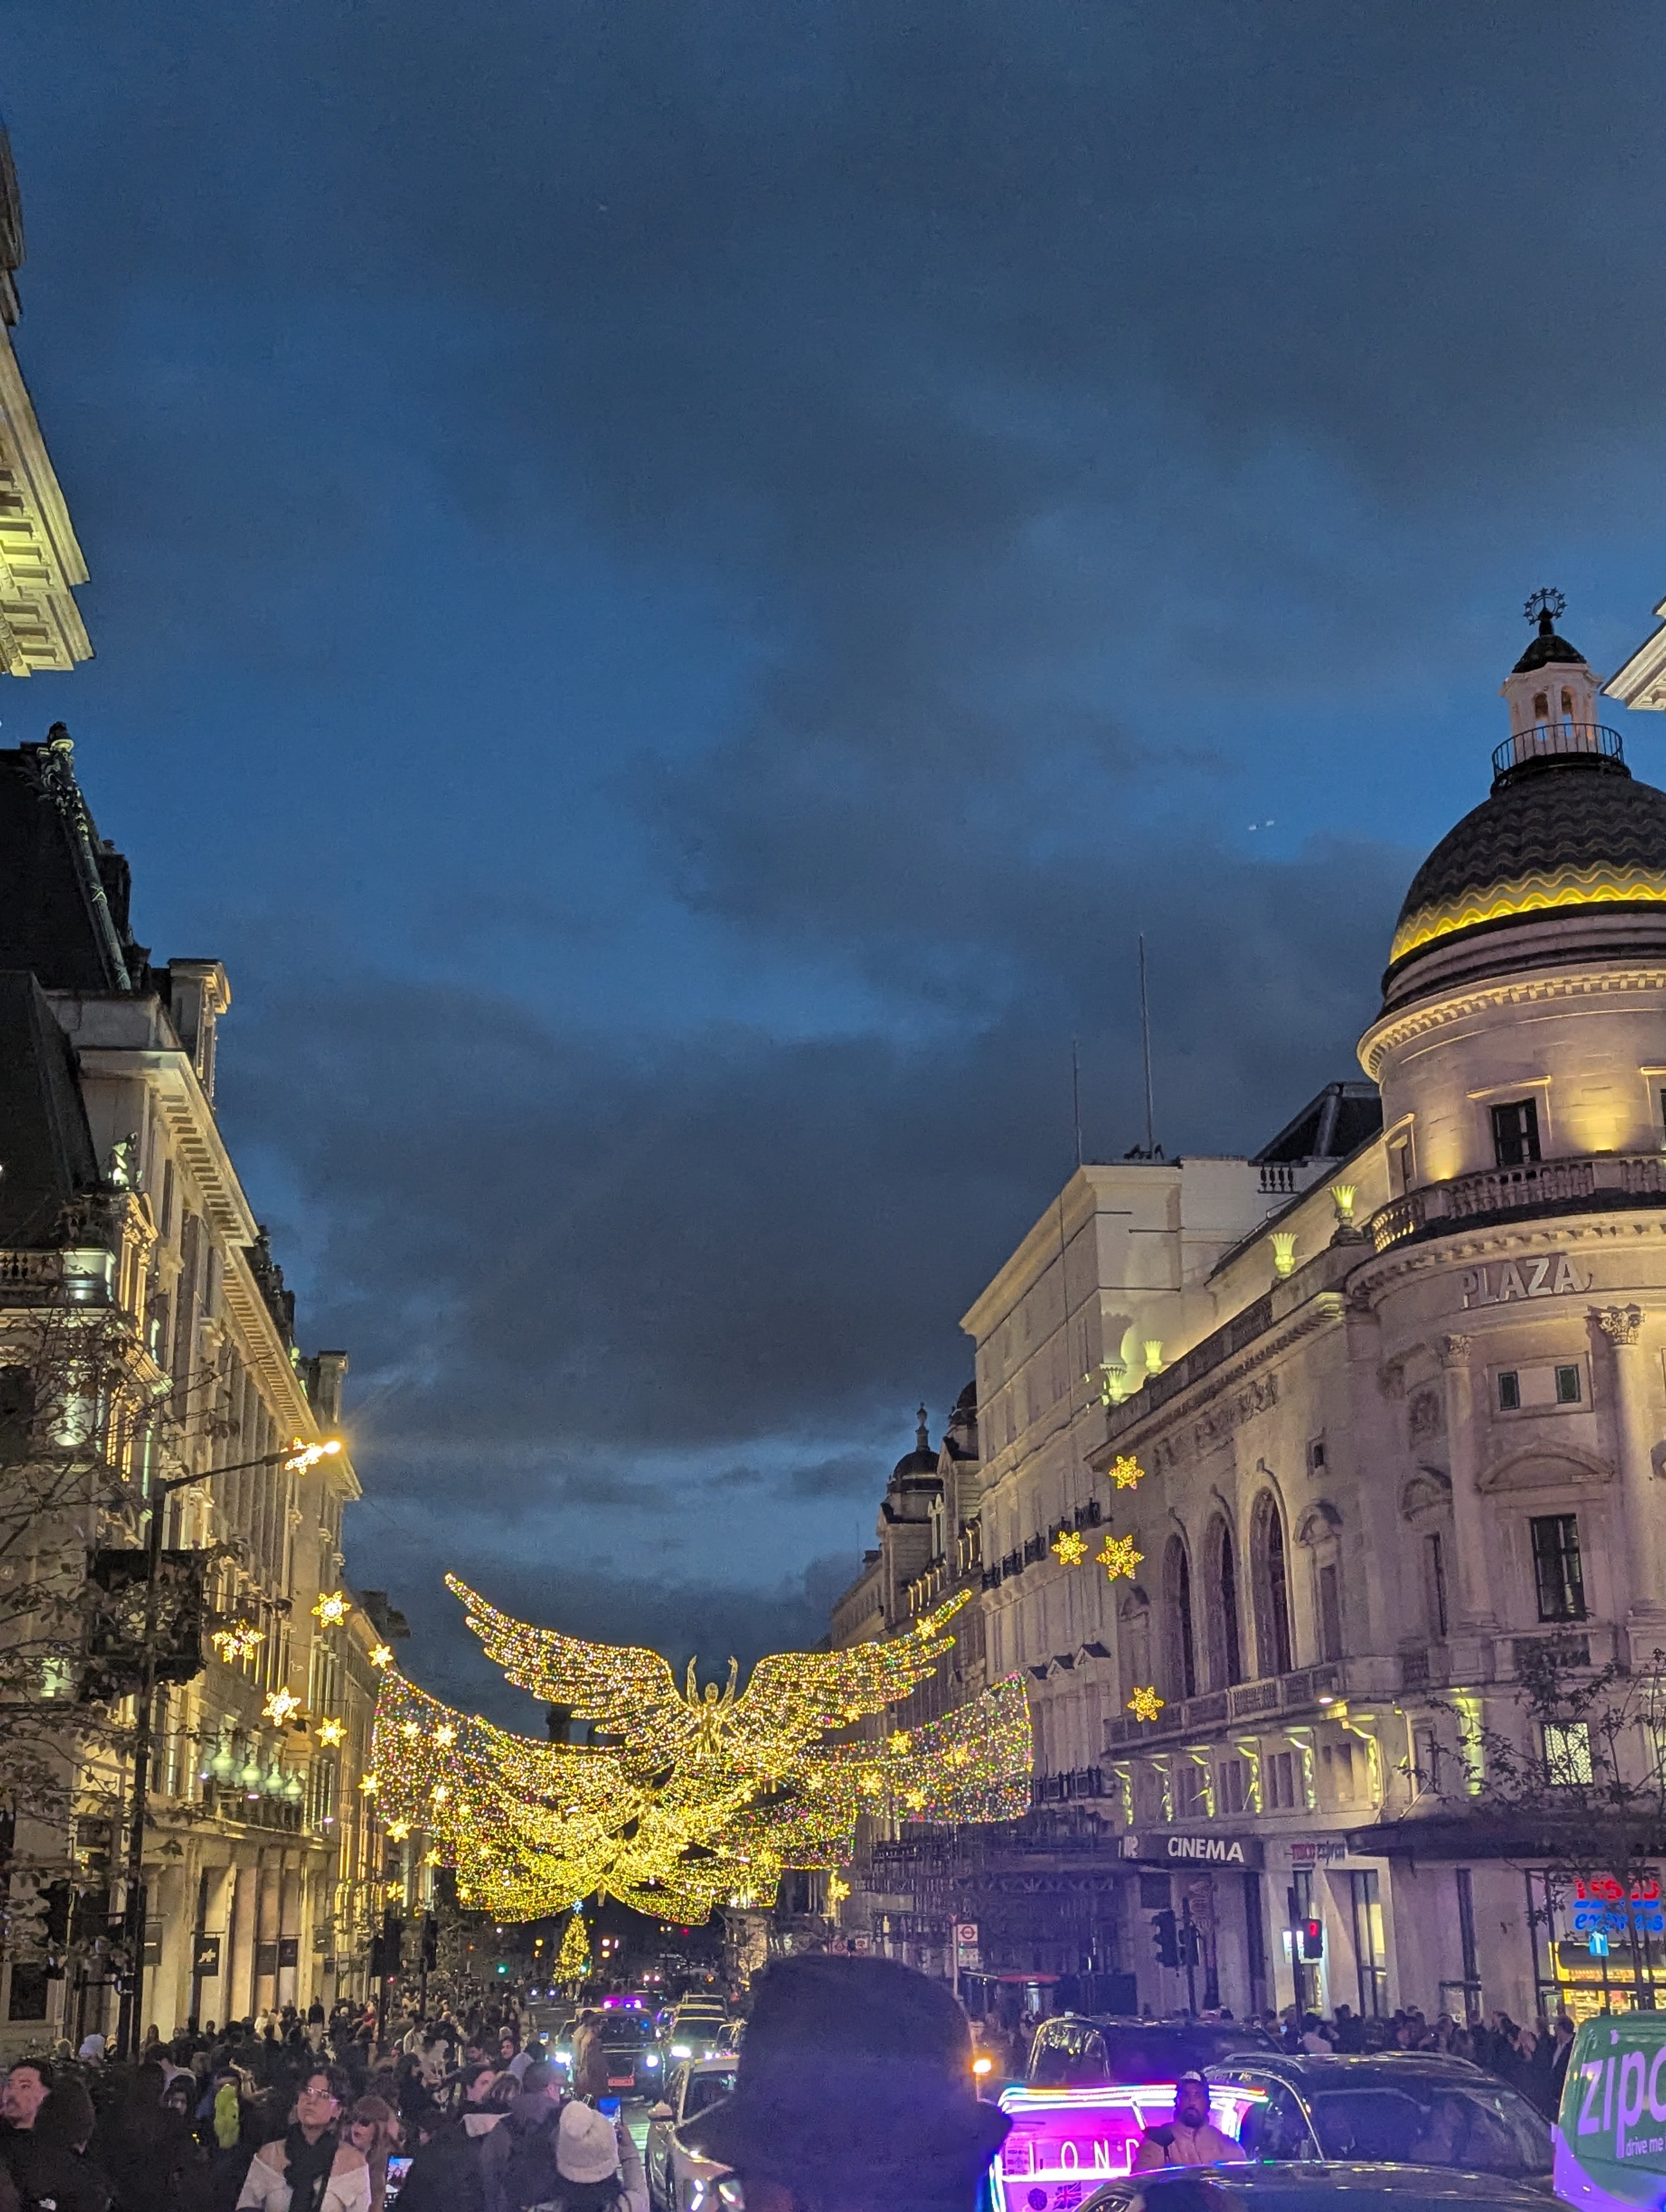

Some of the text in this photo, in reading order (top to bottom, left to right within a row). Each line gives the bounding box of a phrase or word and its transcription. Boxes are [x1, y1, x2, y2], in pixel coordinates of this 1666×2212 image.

[1458, 1255, 1585, 1309] PLAZA
[1168, 1836, 1244, 1862] CINEMA
[1626, 2136, 1663, 2156] drive me
